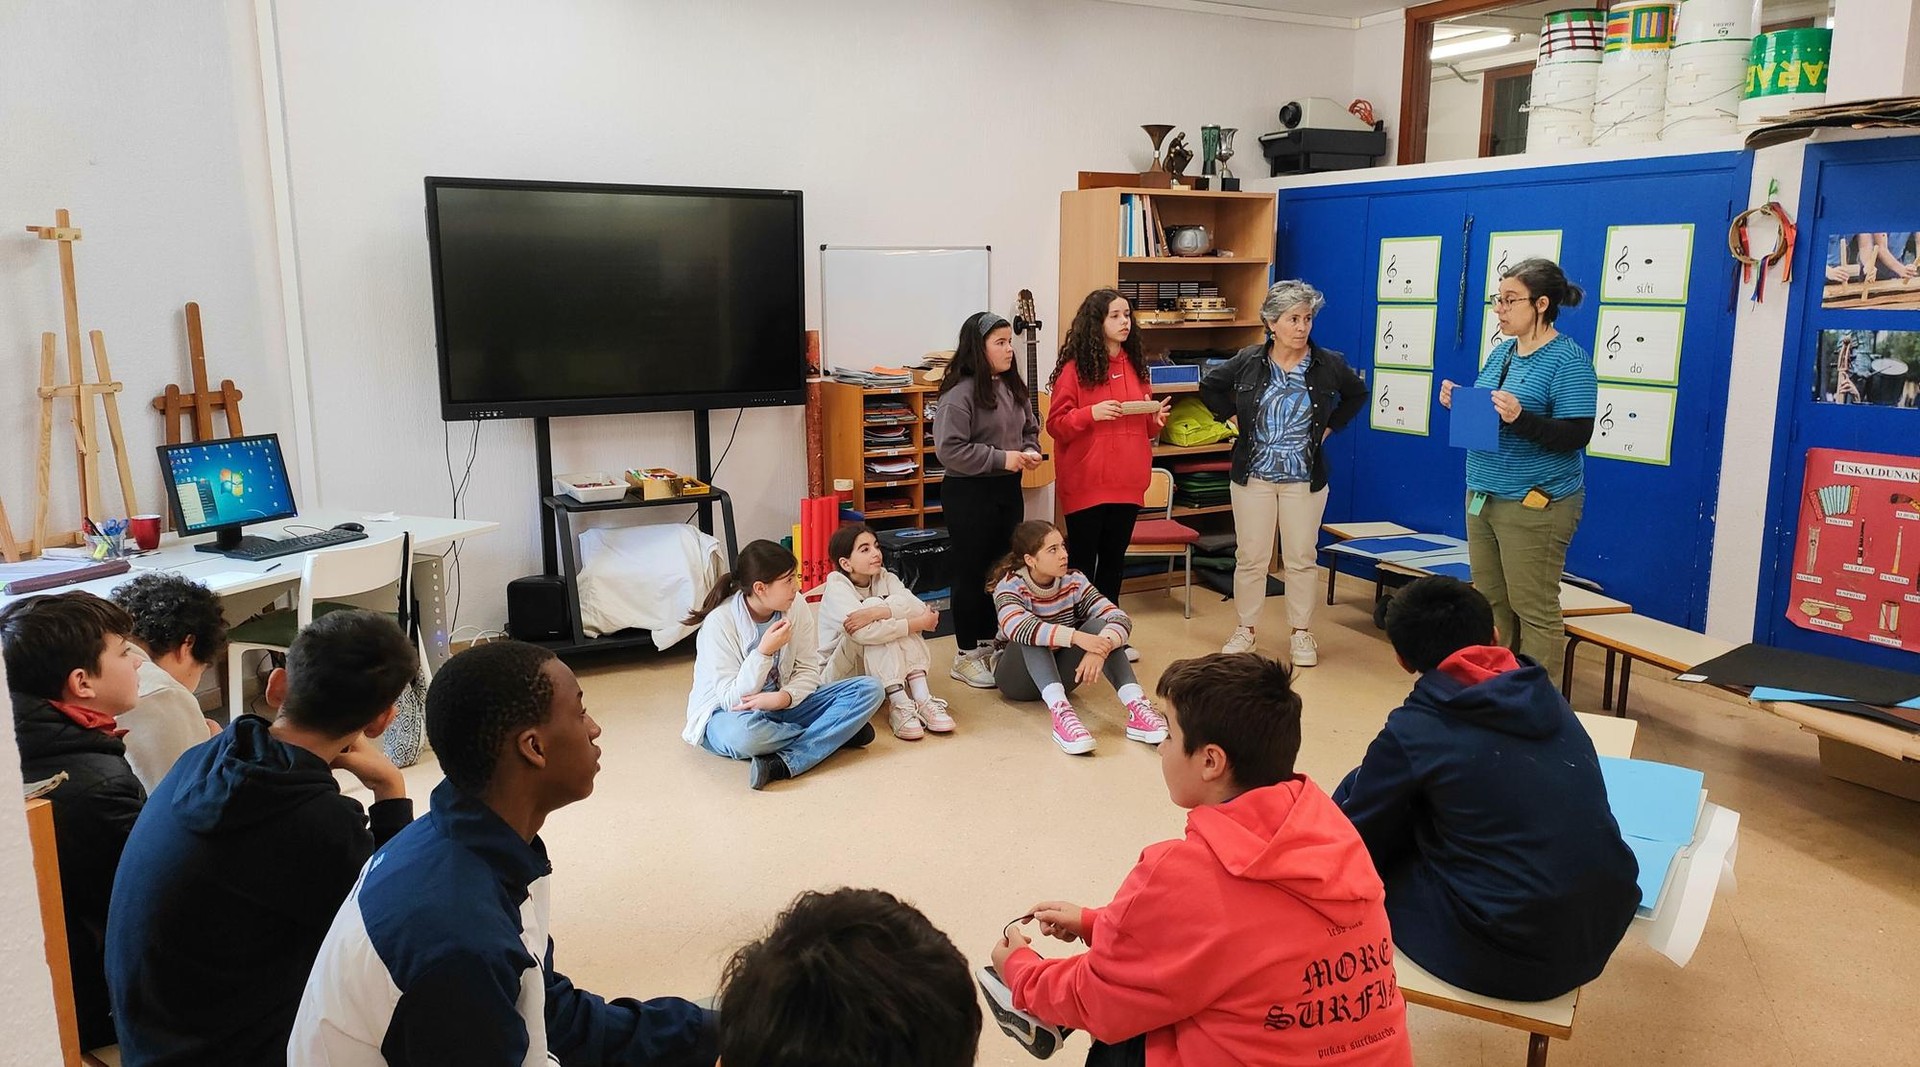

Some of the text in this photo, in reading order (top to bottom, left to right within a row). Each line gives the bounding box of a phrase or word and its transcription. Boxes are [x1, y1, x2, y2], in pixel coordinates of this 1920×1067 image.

[1403, 285, 1413, 294] do
[1636, 282, 1655, 294] si/ti
[1401, 352, 1409, 361] re
[1834, 462, 1919, 482] EUSKALDUNAK
[1302, 938, 1391, 995] MORE
